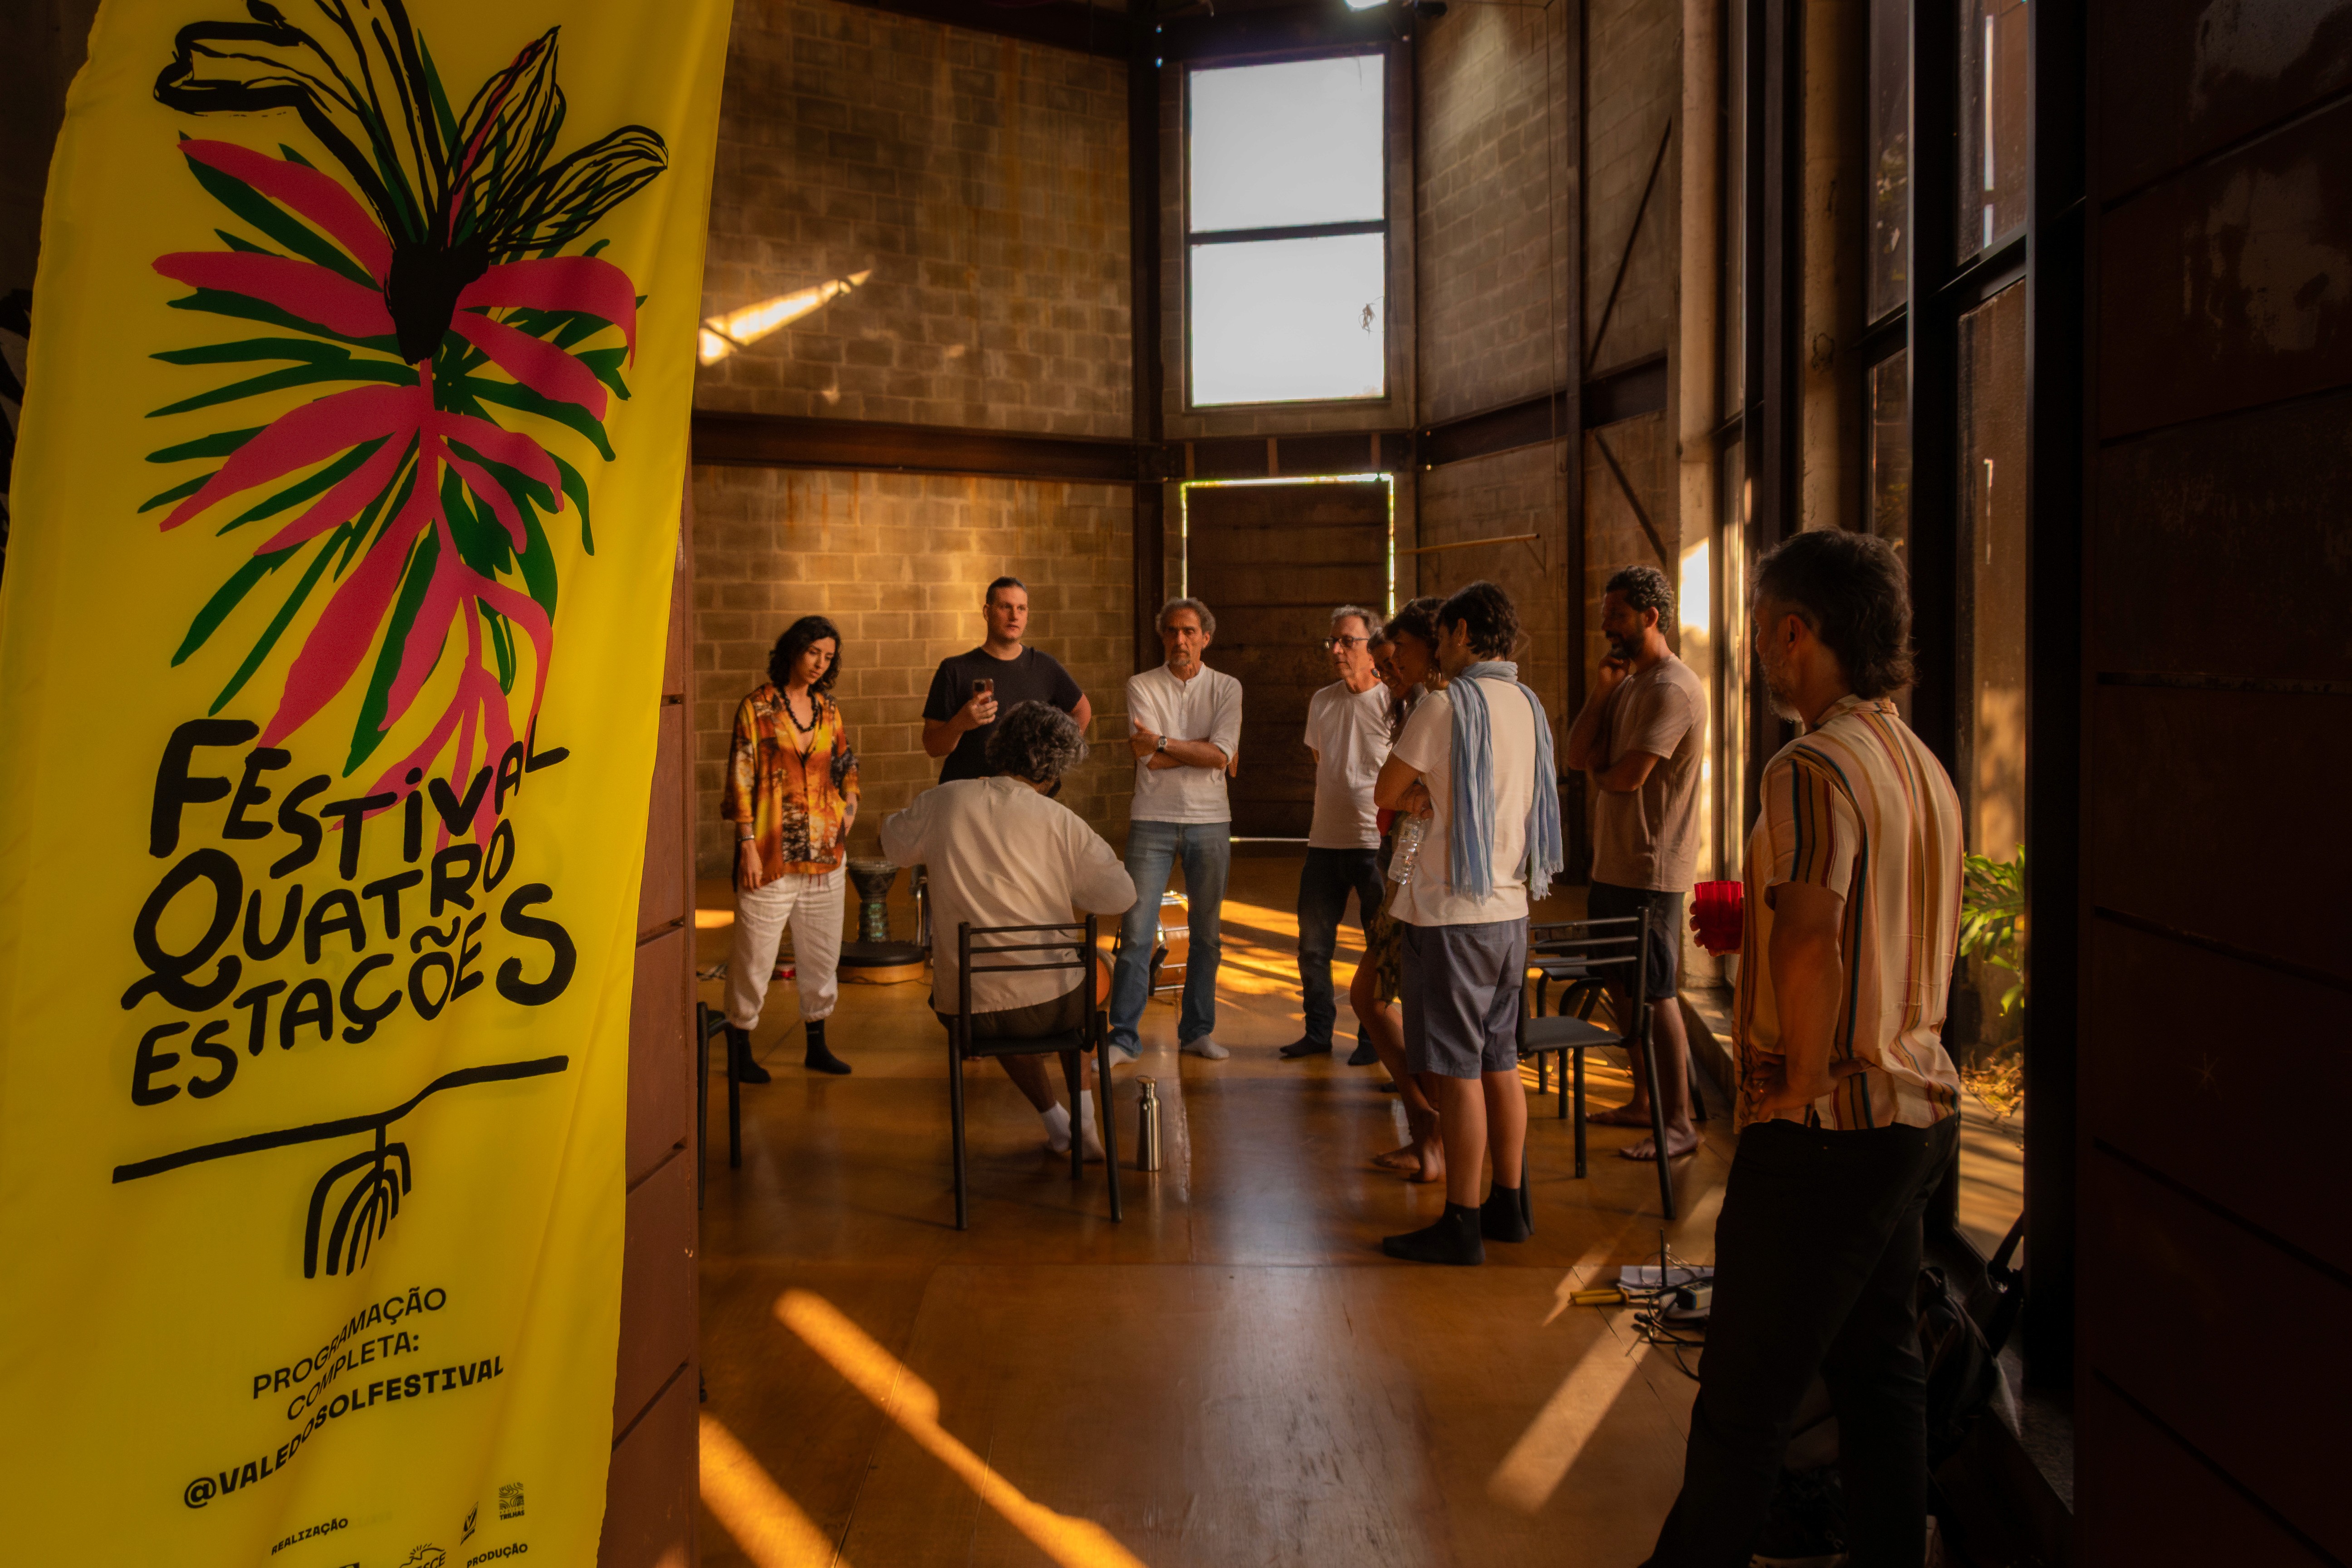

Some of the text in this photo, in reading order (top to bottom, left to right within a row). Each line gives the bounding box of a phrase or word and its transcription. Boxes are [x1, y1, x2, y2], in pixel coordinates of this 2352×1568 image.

[121, 818, 515, 1012] QUATRO
[131, 883, 577, 1107] ESTAÇÕES
[253, 1286, 447, 1400] PROGRAMAÇÃO
[287, 1331, 420, 1421] COMPLETA:
[184, 1356, 505, 1509] @VALEDOSOLFESTIVAL
[271, 1518, 348, 1555] REALIZAÇÃO
[466, 1543, 528, 1568] PRODUÇÃO
[500, 1510, 524, 1520] TRILHAS
